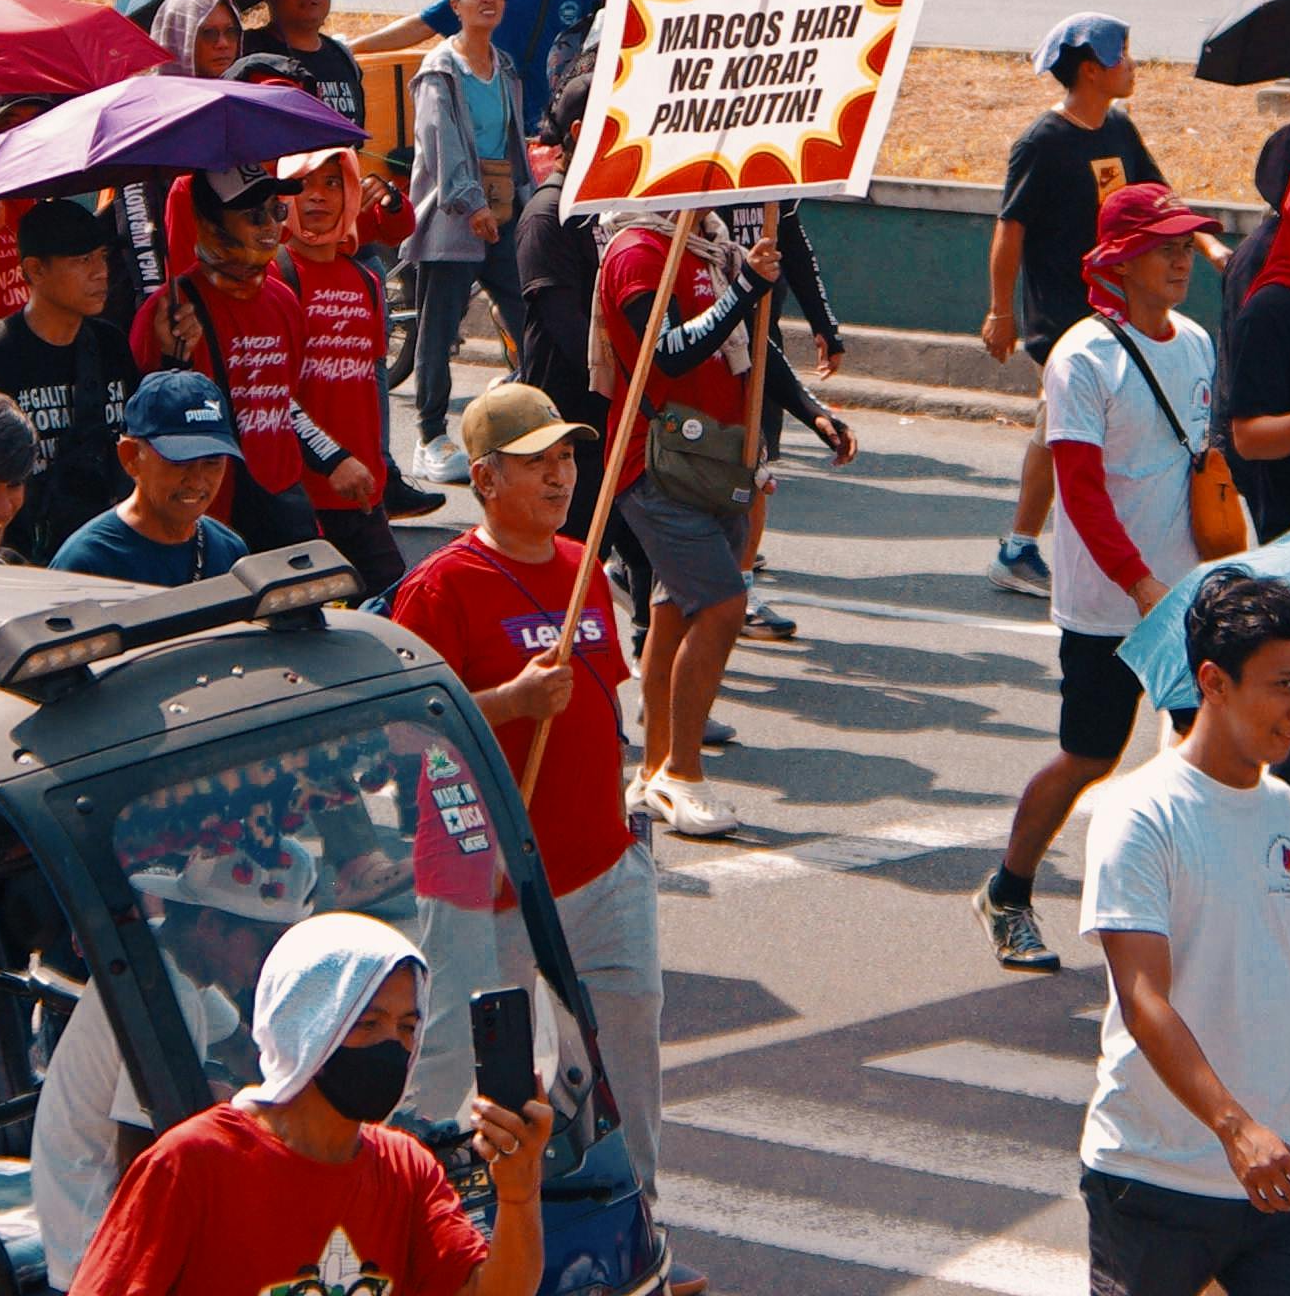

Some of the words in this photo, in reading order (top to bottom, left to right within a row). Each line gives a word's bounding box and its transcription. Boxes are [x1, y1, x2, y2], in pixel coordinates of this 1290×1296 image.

[657, 10, 784, 55] MARCOS
[790, 5, 863, 44] HARI
[669, 57, 714, 94] NG
[719, 48, 819, 91] KORAP,
[648, 88, 823, 136] PANAGUTIN!
